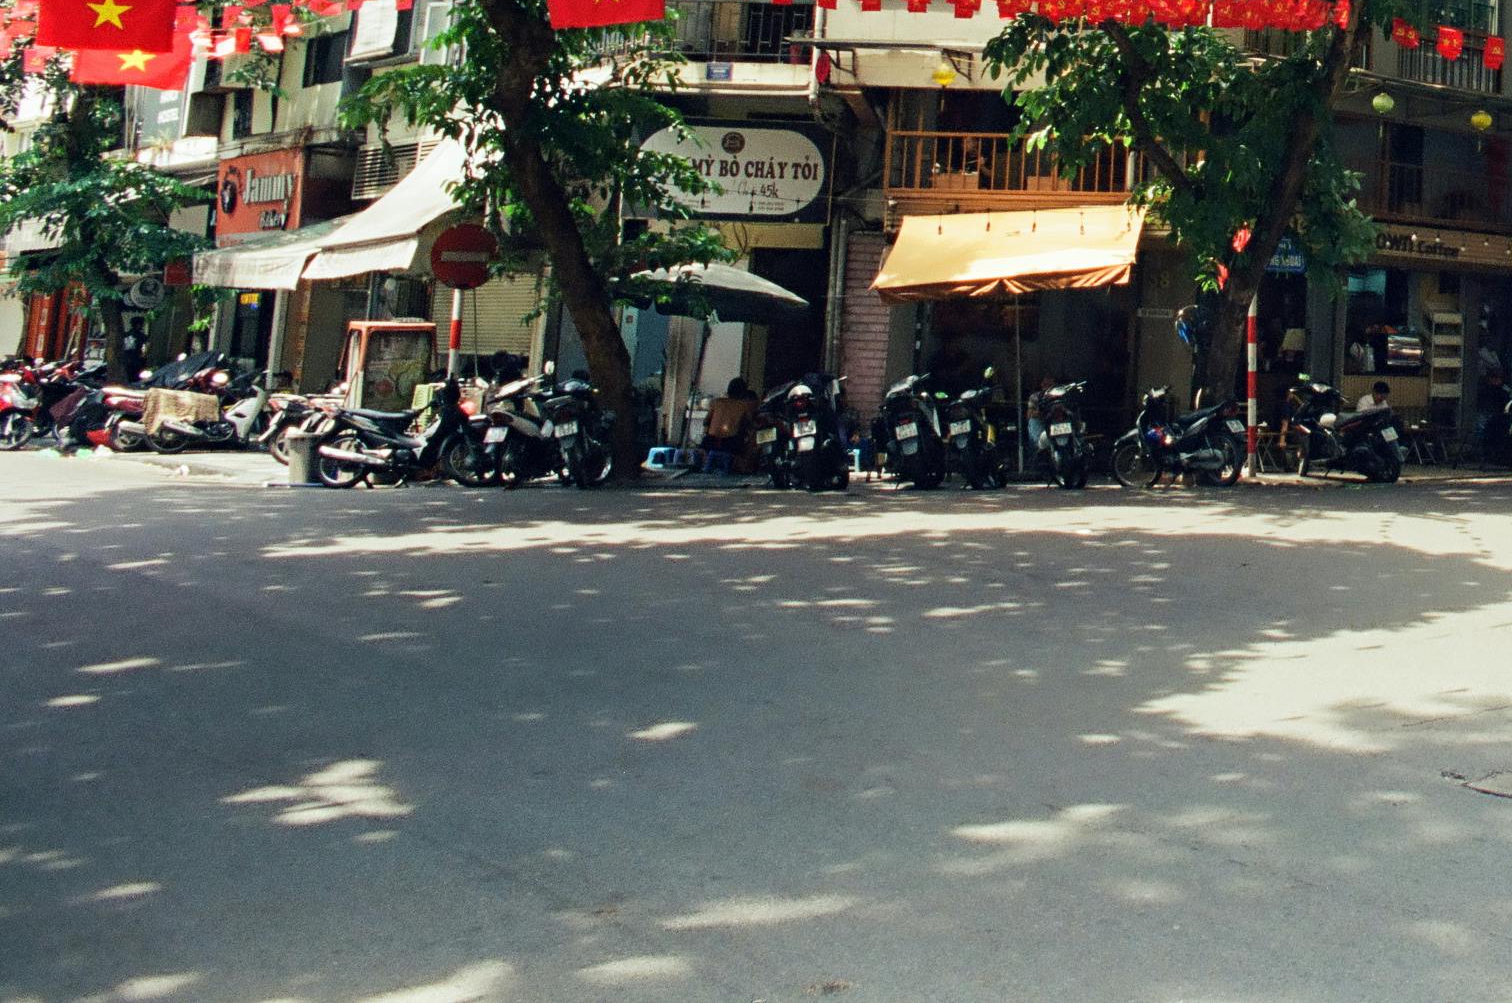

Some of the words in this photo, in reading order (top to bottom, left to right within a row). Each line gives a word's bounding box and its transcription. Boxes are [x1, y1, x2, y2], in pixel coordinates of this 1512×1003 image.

[719, 155, 740, 177] BÒ
[744, 156, 788, 180] CHÁY
[792, 155, 819, 181] TỎI
[242, 168, 294, 214] Jammy
[760, 181, 778, 199] 45k
